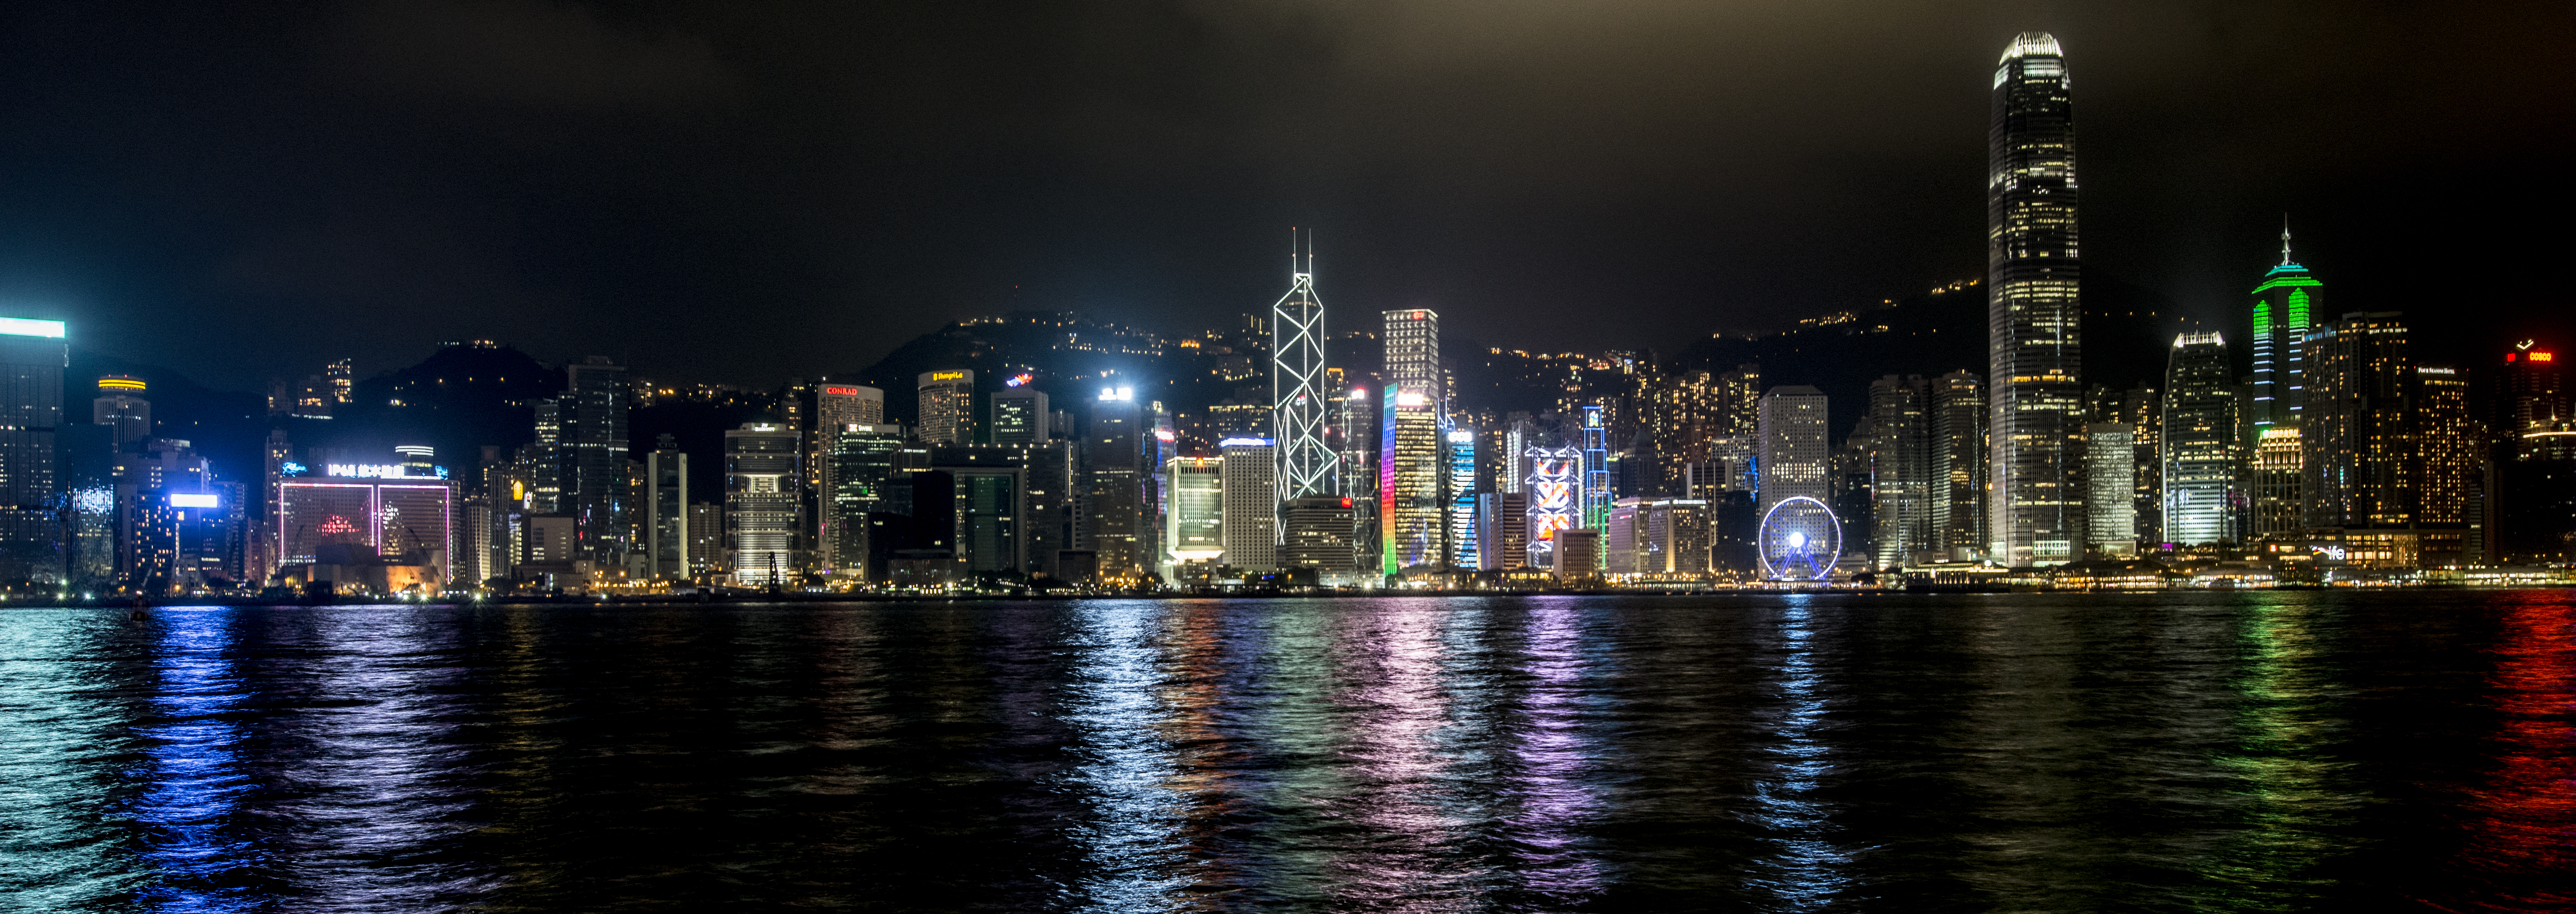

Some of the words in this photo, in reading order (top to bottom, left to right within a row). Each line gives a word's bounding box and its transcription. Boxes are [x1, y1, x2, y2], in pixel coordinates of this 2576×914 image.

[2530, 352, 2551, 361] COSCO
[827, 387, 857, 395] CONRAD
[328, 464, 356, 476] IP68
